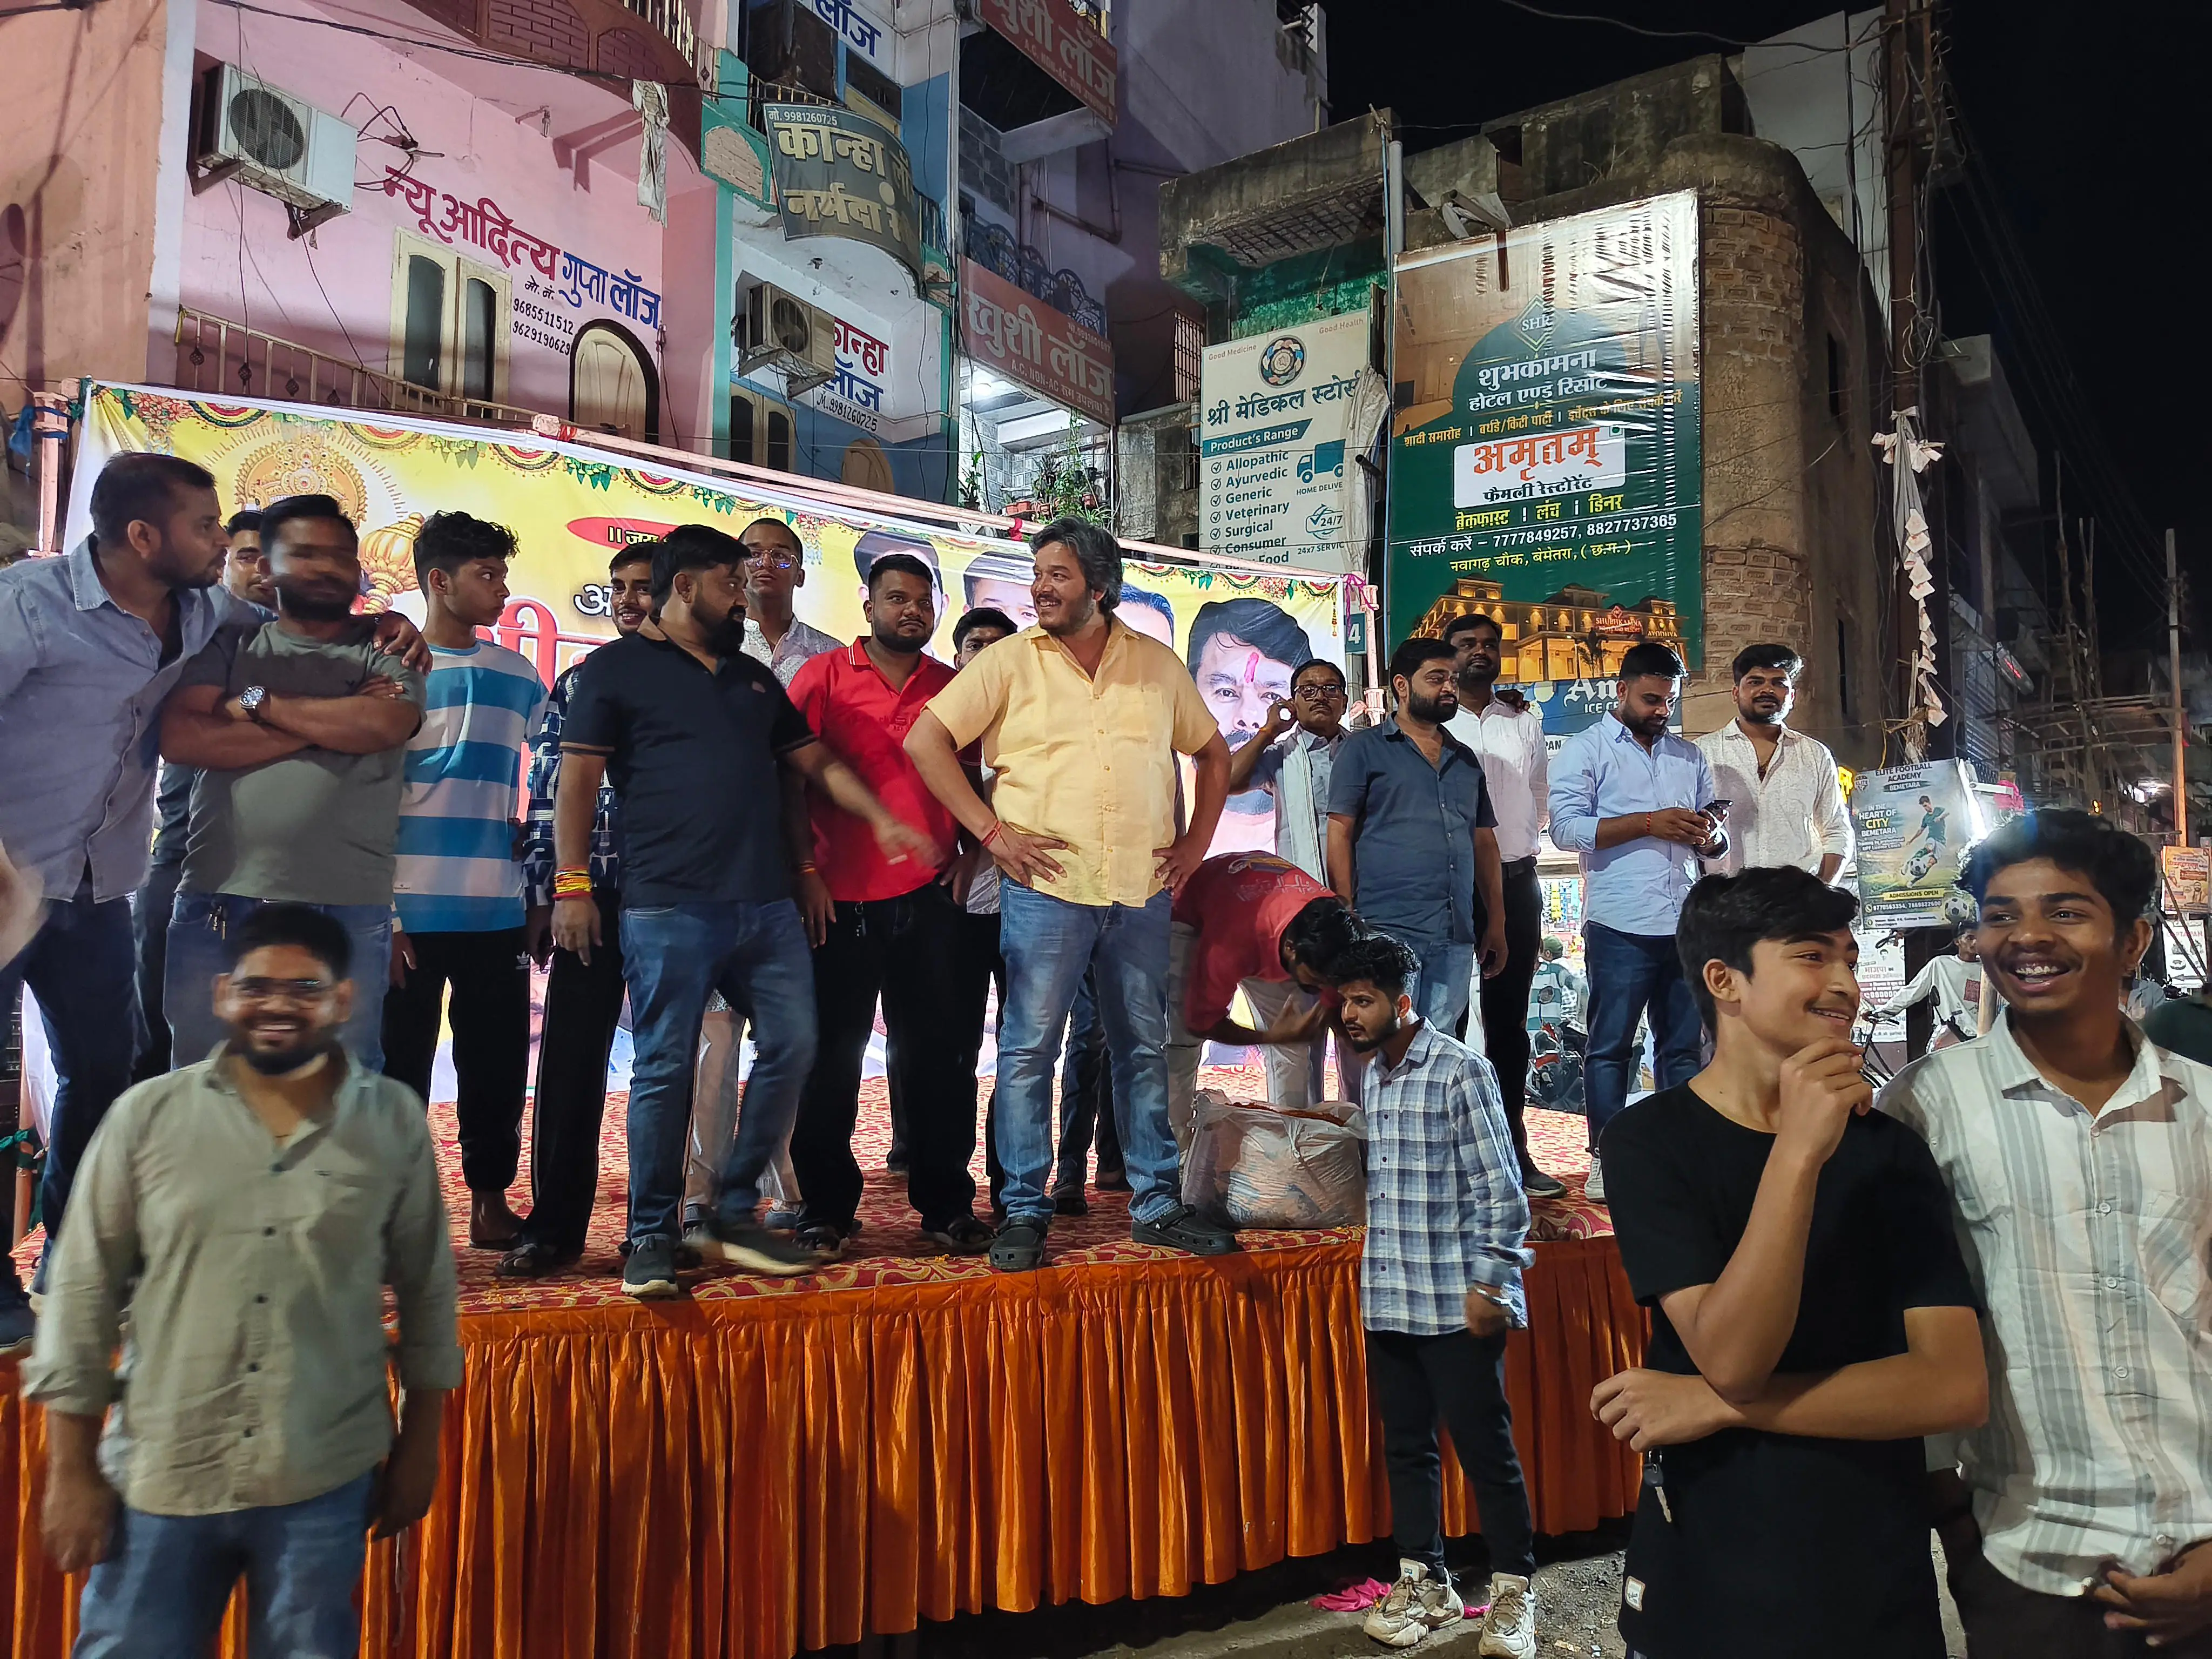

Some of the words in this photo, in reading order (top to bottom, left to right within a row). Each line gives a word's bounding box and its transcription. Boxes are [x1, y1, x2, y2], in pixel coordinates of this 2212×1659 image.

[1058, 25, 1116, 106] लॉज
[784, 111, 838, 125] 9981260725
[773, 122, 886, 177] कान्हा
[783, 183, 882, 234] नर्मदा
[384, 165, 453, 244] न्यू
[440, 193, 561, 281] आदित्य
[558, 251, 609, 308] गुप्ता
[610, 268, 661, 329] लॉज
[513, 298, 574, 335] 9685511512
[1319, 325, 1338, 335] Good
[1339, 318, 1364, 330] Health
[512, 320, 571, 355] 9629190629
[966, 289, 1043, 366] खुशी
[1048, 331, 1112, 402] लॉज
[1209, 352, 1225, 361] Good
[1227, 343, 1257, 357] Medicine
[1029, 367, 1059, 393] NON-AC
[1478, 349, 1597, 391] शुभकामना
[1207, 399, 1230, 427] श्री
[1235, 389, 1306, 420] मेडिकल
[1468, 391, 1512, 412] होटल
[1516, 383, 1554, 403] एण्ड
[1264, 427, 1299, 442] Range
[1404, 432, 1425, 448] शादी
[1427, 426, 1462, 444] समारोह
[1226, 449, 1289, 471] Allopathic
[1474, 427, 1603, 481] अमृतम्
[1226, 467, 1288, 489] Ayurvedic
[1225, 486, 1272, 504] Generic
[1296, 485, 1317, 496] HOME
[1225, 502, 1290, 521] Veterinary
[1535, 500, 1562, 521] लंच
[1588, 493, 1624, 513] डिनर
[1225, 519, 1273, 538] Surgical
[1320, 515, 1343, 527] 24/7
[1225, 536, 1287, 554] Consumer
[1410, 538, 1446, 557] संपर्क
[1450, 535, 1473, 552] करें
[1493, 525, 1582, 548] 7777849257,
[1587, 514, 1677, 536] 8827737365
[1297, 545, 1316, 555] 24x7
[1494, 551, 1529, 567] चौक,
[1532, 545, 1577, 563] बेमेतरा,
[1584, 703, 1602, 714] ICE
[1875, 768, 1893, 777] ELITE
[1896, 763, 1932, 773] FOOTBALL
[1887, 772, 1921, 783] ACADEMY
[1859, 810, 1885, 820] HEART
[1885, 808, 1897, 817] OF
[1866, 817, 1889, 829] CITY
[1861, 827, 1897, 837] BEMETARA
